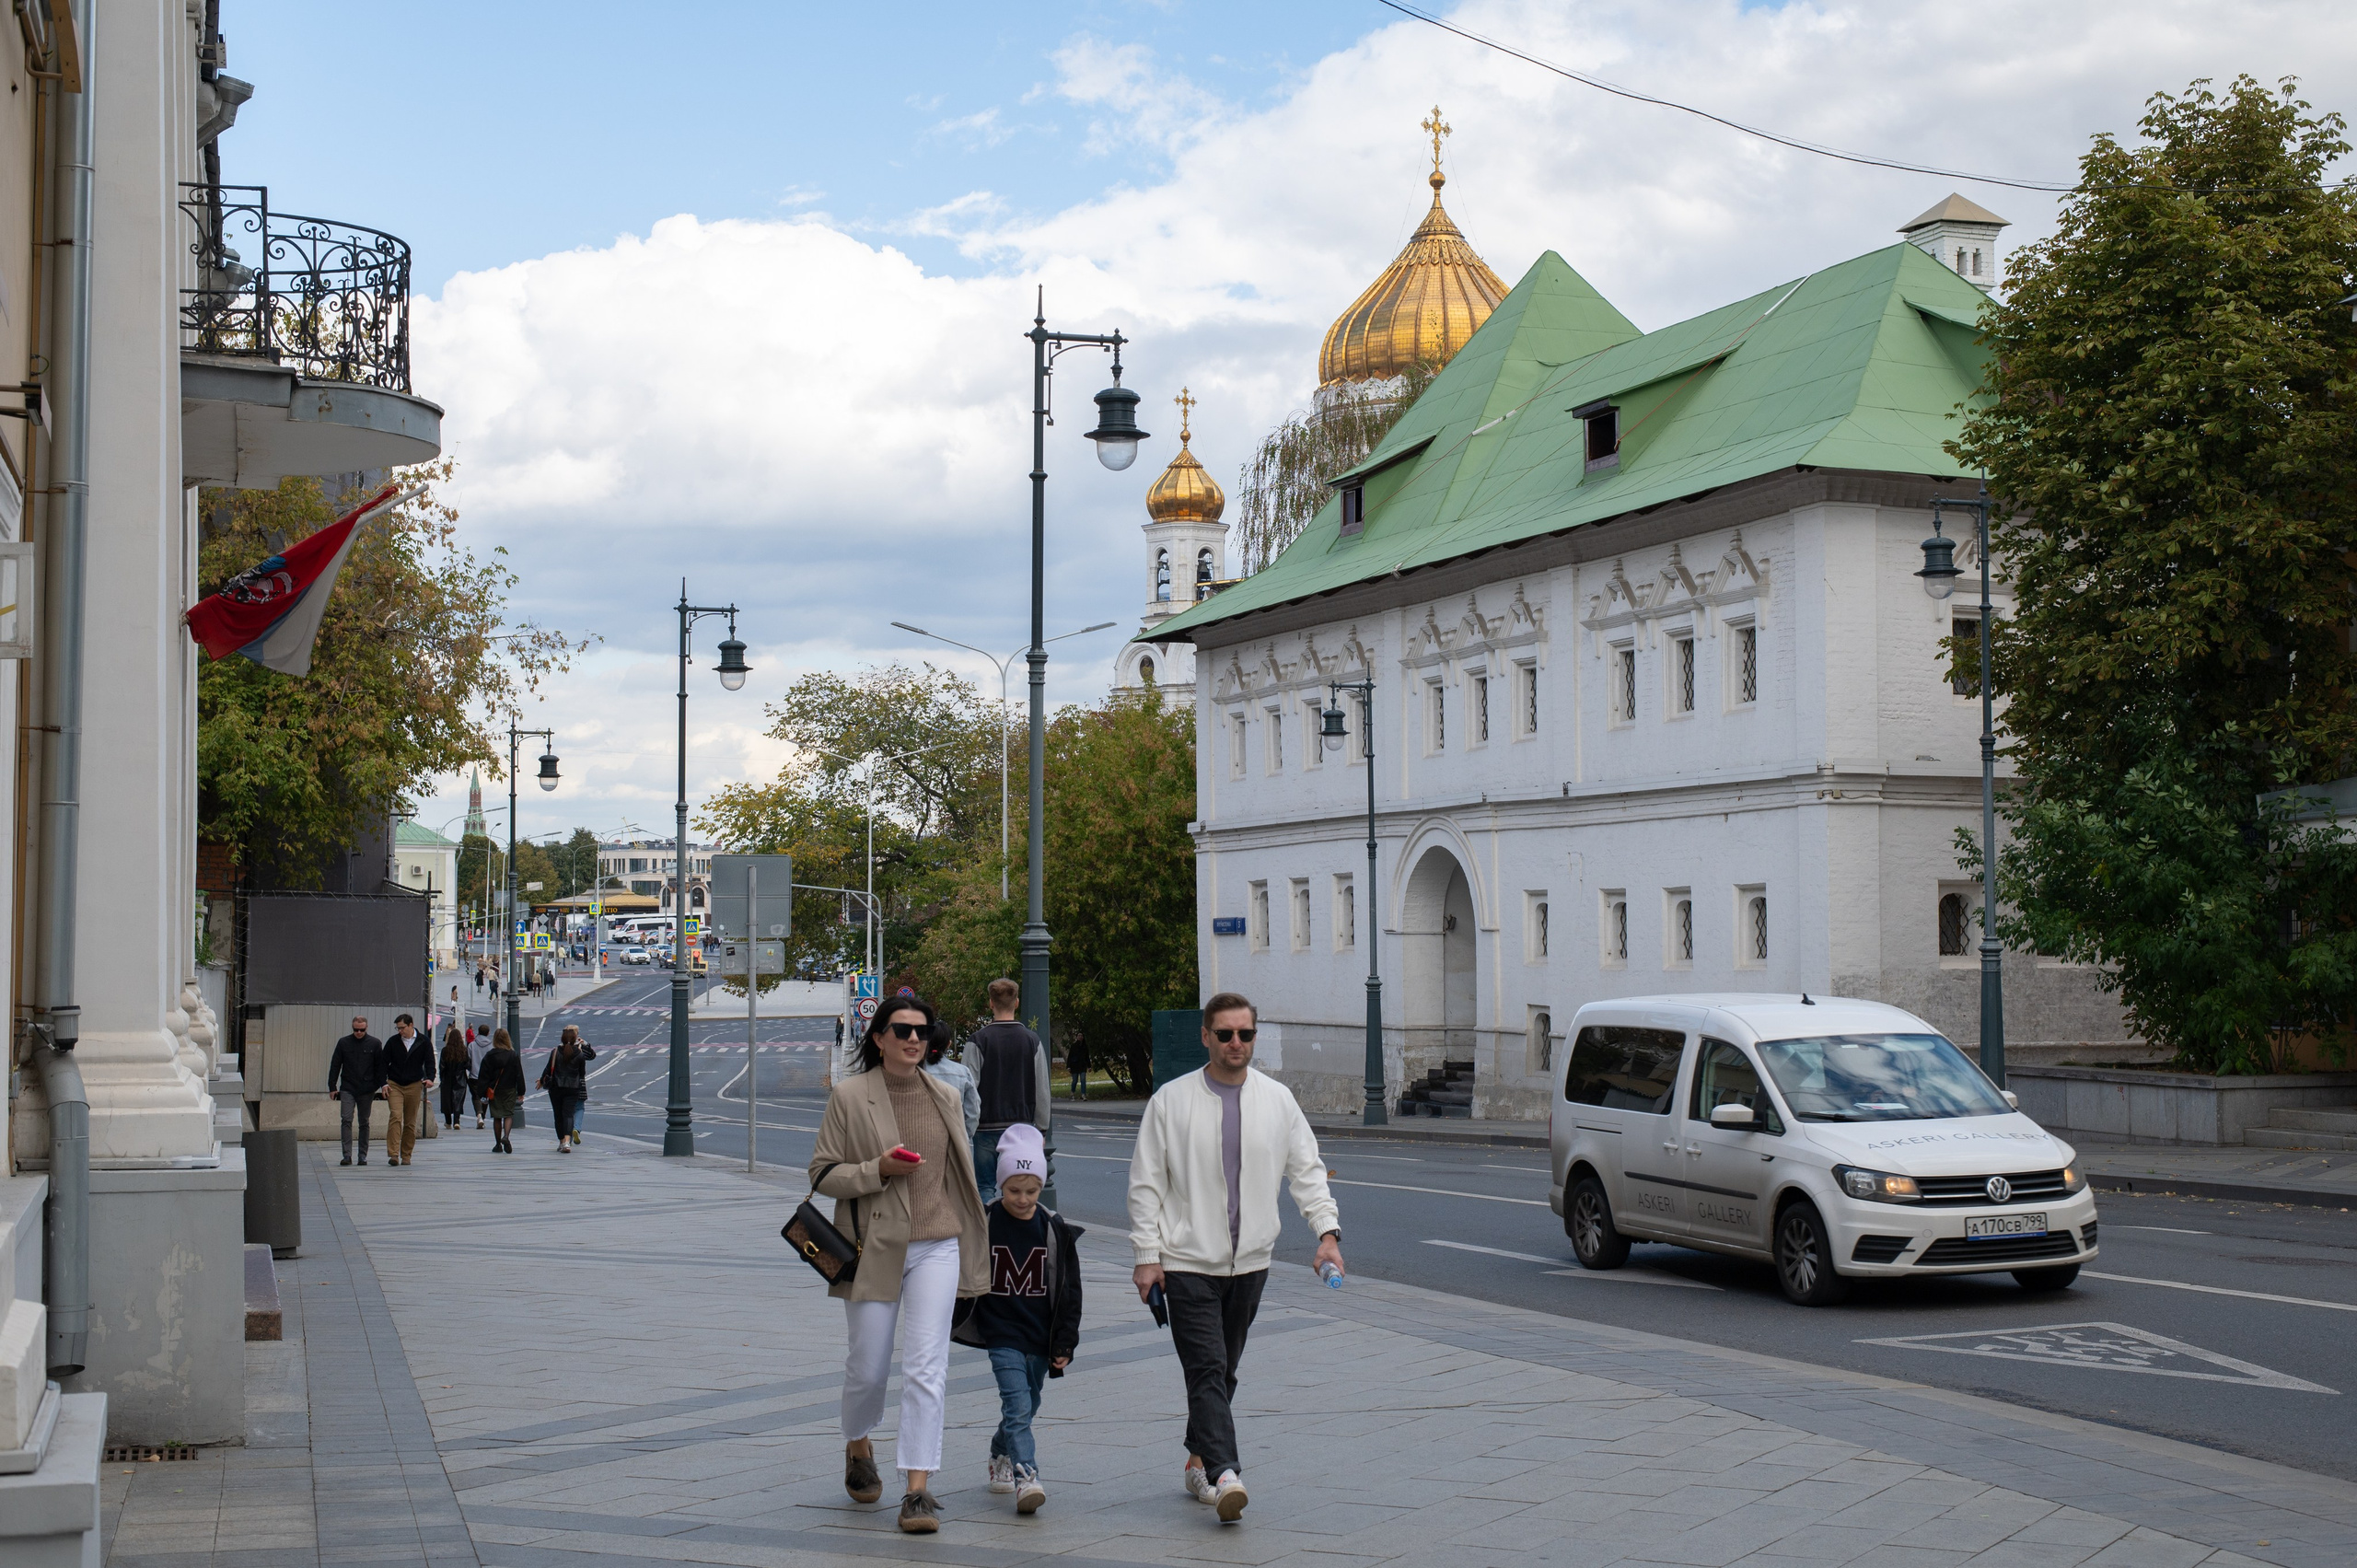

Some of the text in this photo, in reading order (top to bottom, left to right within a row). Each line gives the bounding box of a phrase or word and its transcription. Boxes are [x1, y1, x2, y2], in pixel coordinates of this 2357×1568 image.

[863, 1005, 876, 1013] 50
[1867, 1132, 2049, 1150] ASKERI GALLERY
[1016, 1159, 1033, 1170] NY
[1638, 1192, 1751, 1226] ASKERI GALLERY
[2023, 1214, 2042, 1227] 799
[990, 1245, 1048, 1296] M
